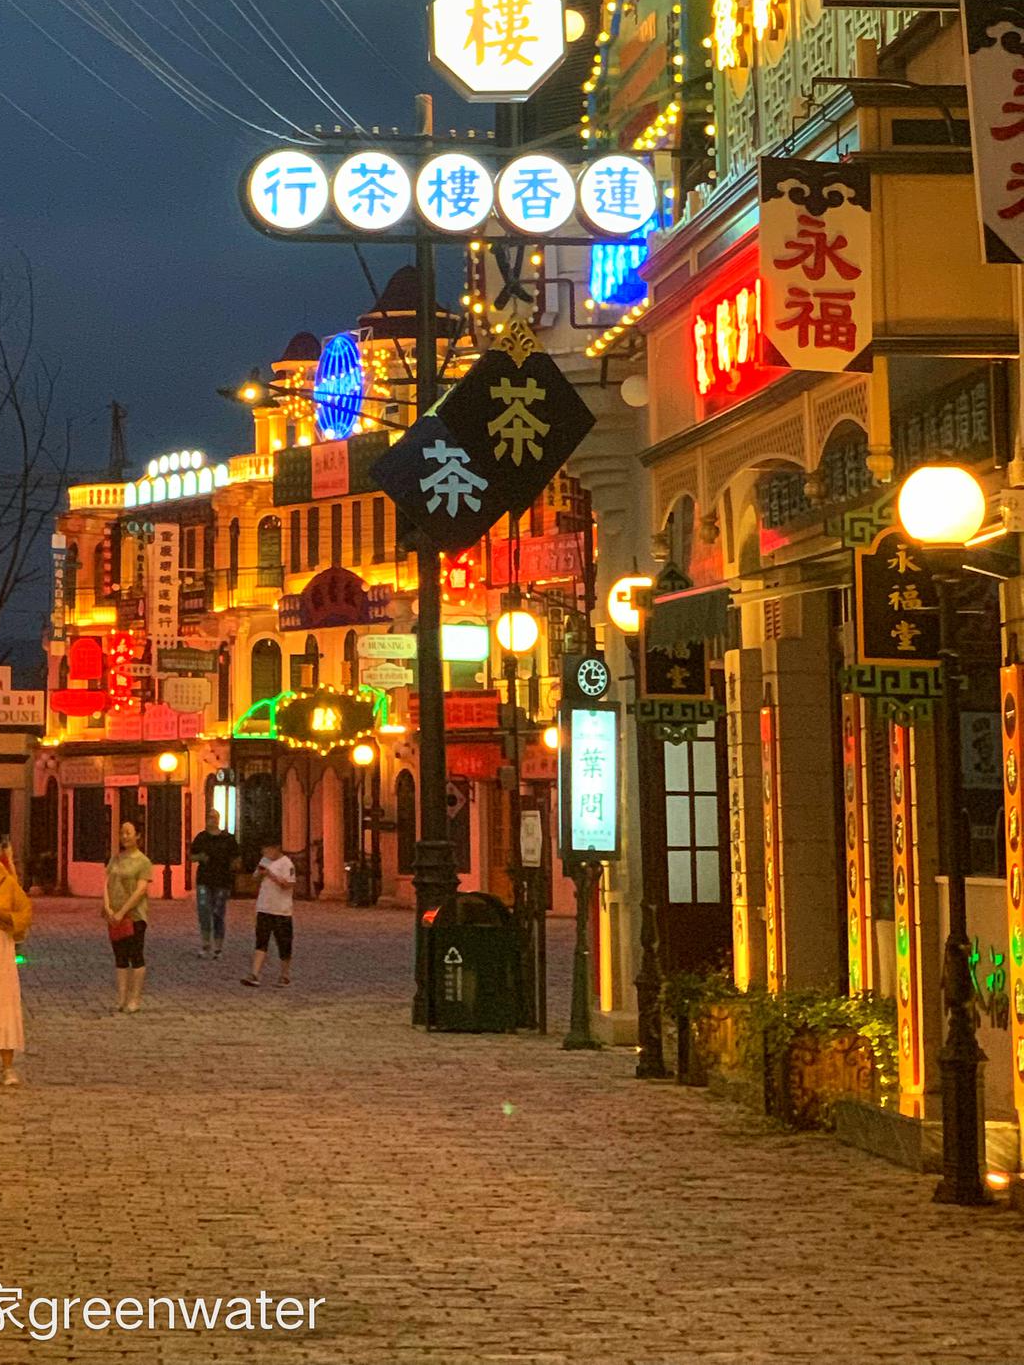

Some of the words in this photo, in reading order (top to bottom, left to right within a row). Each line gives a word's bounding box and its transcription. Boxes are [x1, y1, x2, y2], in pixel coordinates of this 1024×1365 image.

[773, 214, 863, 353] 永福
[487, 377, 551, 467] 茶
[419, 439, 489, 519] 茶
[886, 544, 923, 652] 永福堂
[579, 746, 608, 822] 葉問
